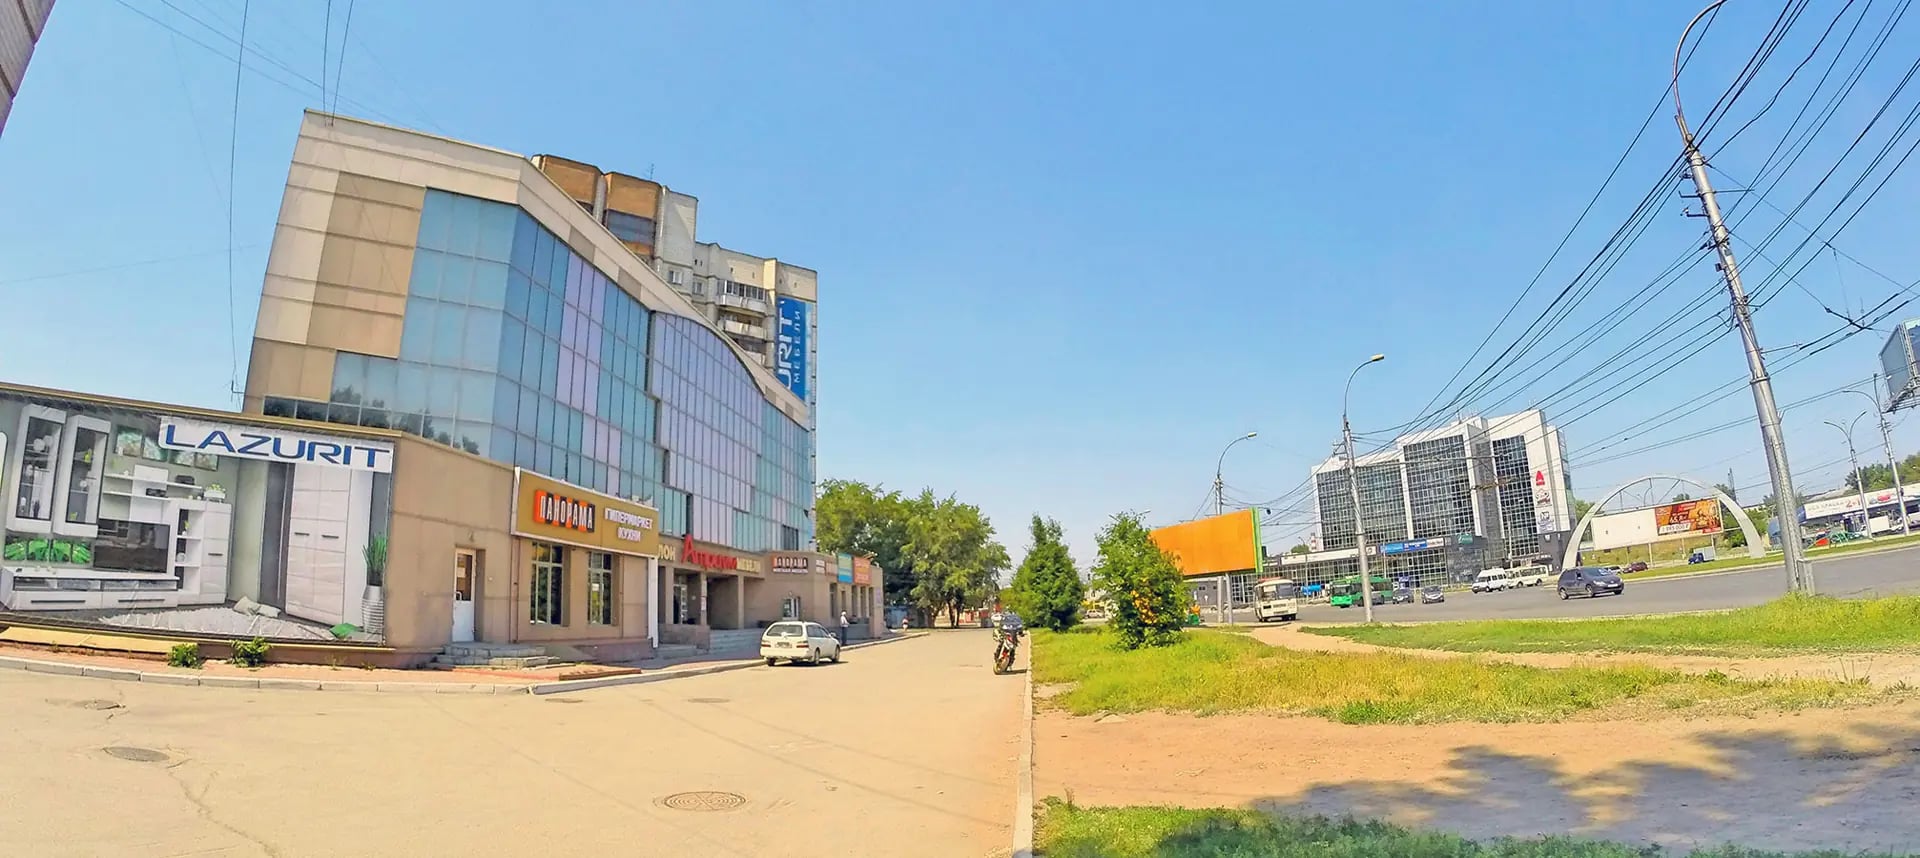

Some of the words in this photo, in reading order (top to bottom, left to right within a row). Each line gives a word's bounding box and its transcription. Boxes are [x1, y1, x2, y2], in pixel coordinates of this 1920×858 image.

[165, 424, 391, 468] LAZURIT
[538, 493, 595, 530] ПАНОРАМА
[604, 507, 653, 530] ГИПЕРМАРКЕТ
[617, 526, 641, 542] КУХНИ
[773, 556, 808, 568] ПАНОРАМА
